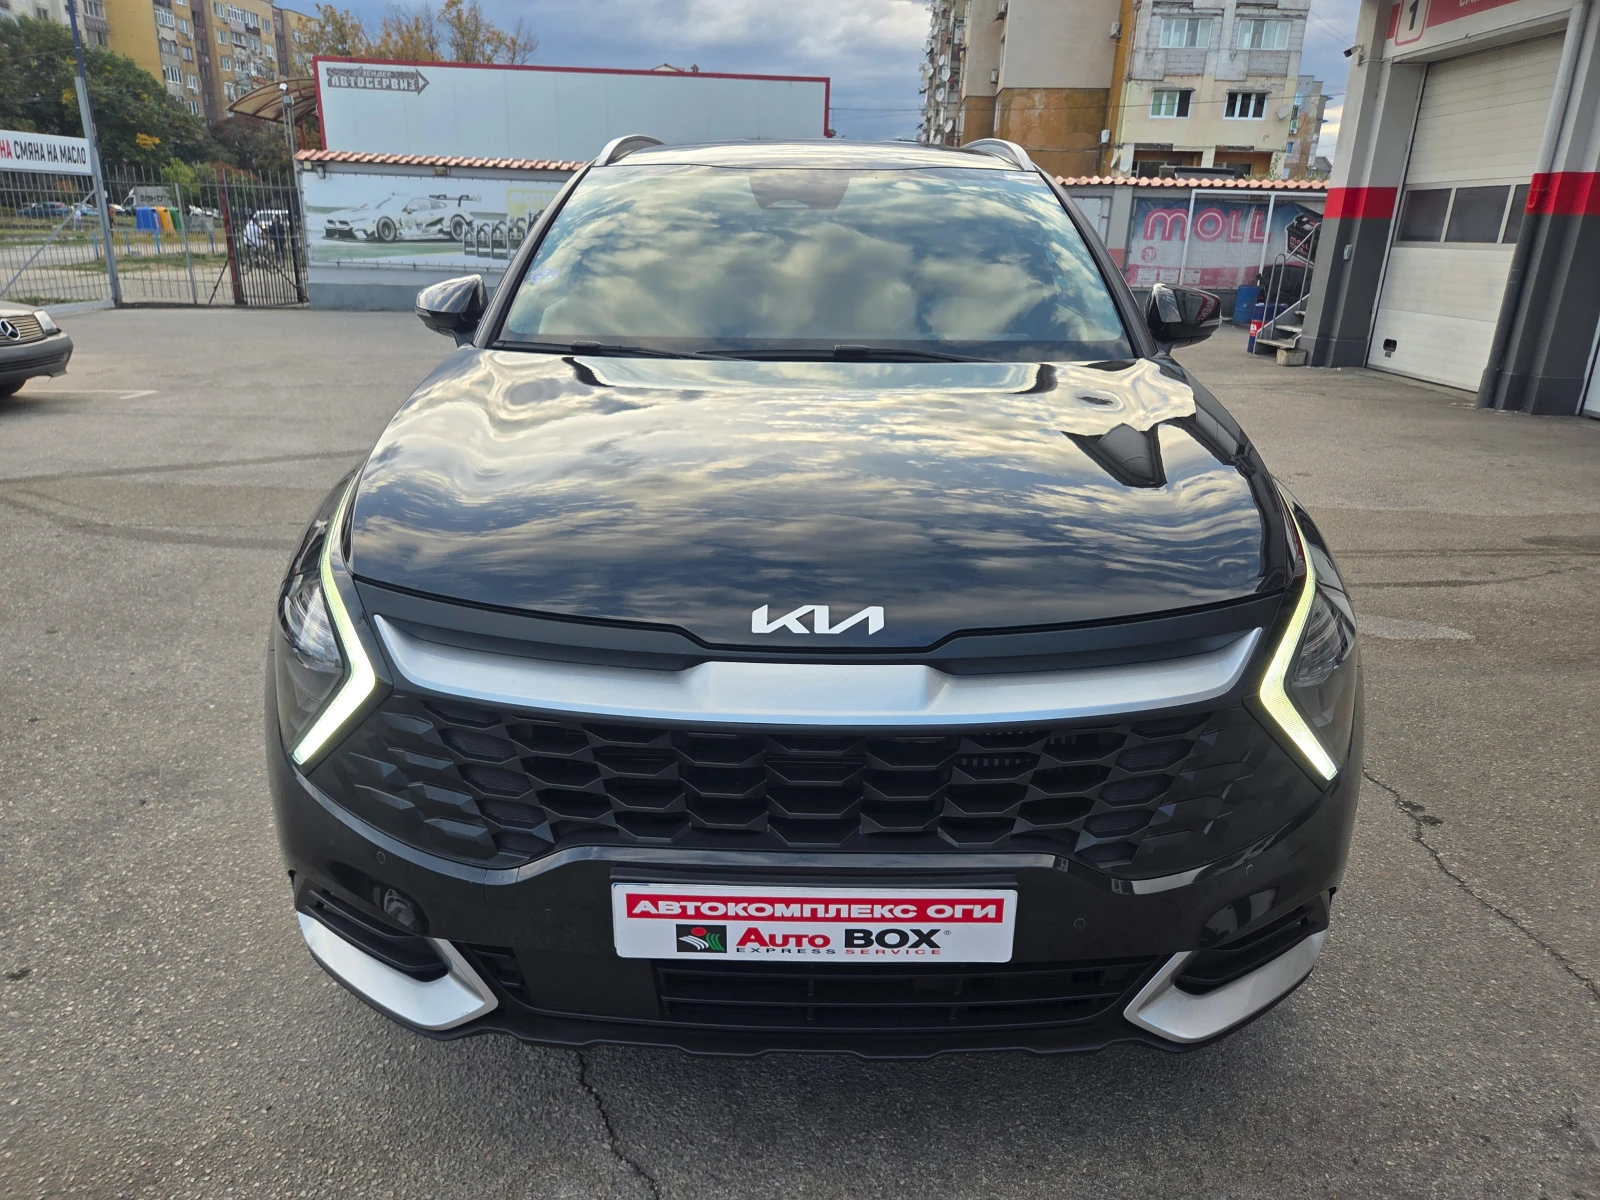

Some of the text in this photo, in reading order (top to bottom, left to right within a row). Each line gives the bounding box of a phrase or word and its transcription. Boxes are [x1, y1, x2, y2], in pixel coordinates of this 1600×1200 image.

[1408, 0, 1419, 32] 1
[331, 75, 416, 90] АВТОСЕРВИЗ
[14, 140, 46, 162] СМЯНА
[47, 143, 59, 162] НА
[60, 144, 87, 165] МАСЛО
[509, 191, 557, 204] MOTU
[751, 604, 885, 636] KIA
[631, 900, 997, 919] АВТОКОМПЛЕКС ОГИ
[844, 928, 942, 949] BOX
[736, 947, 836, 955] EXPRESS
